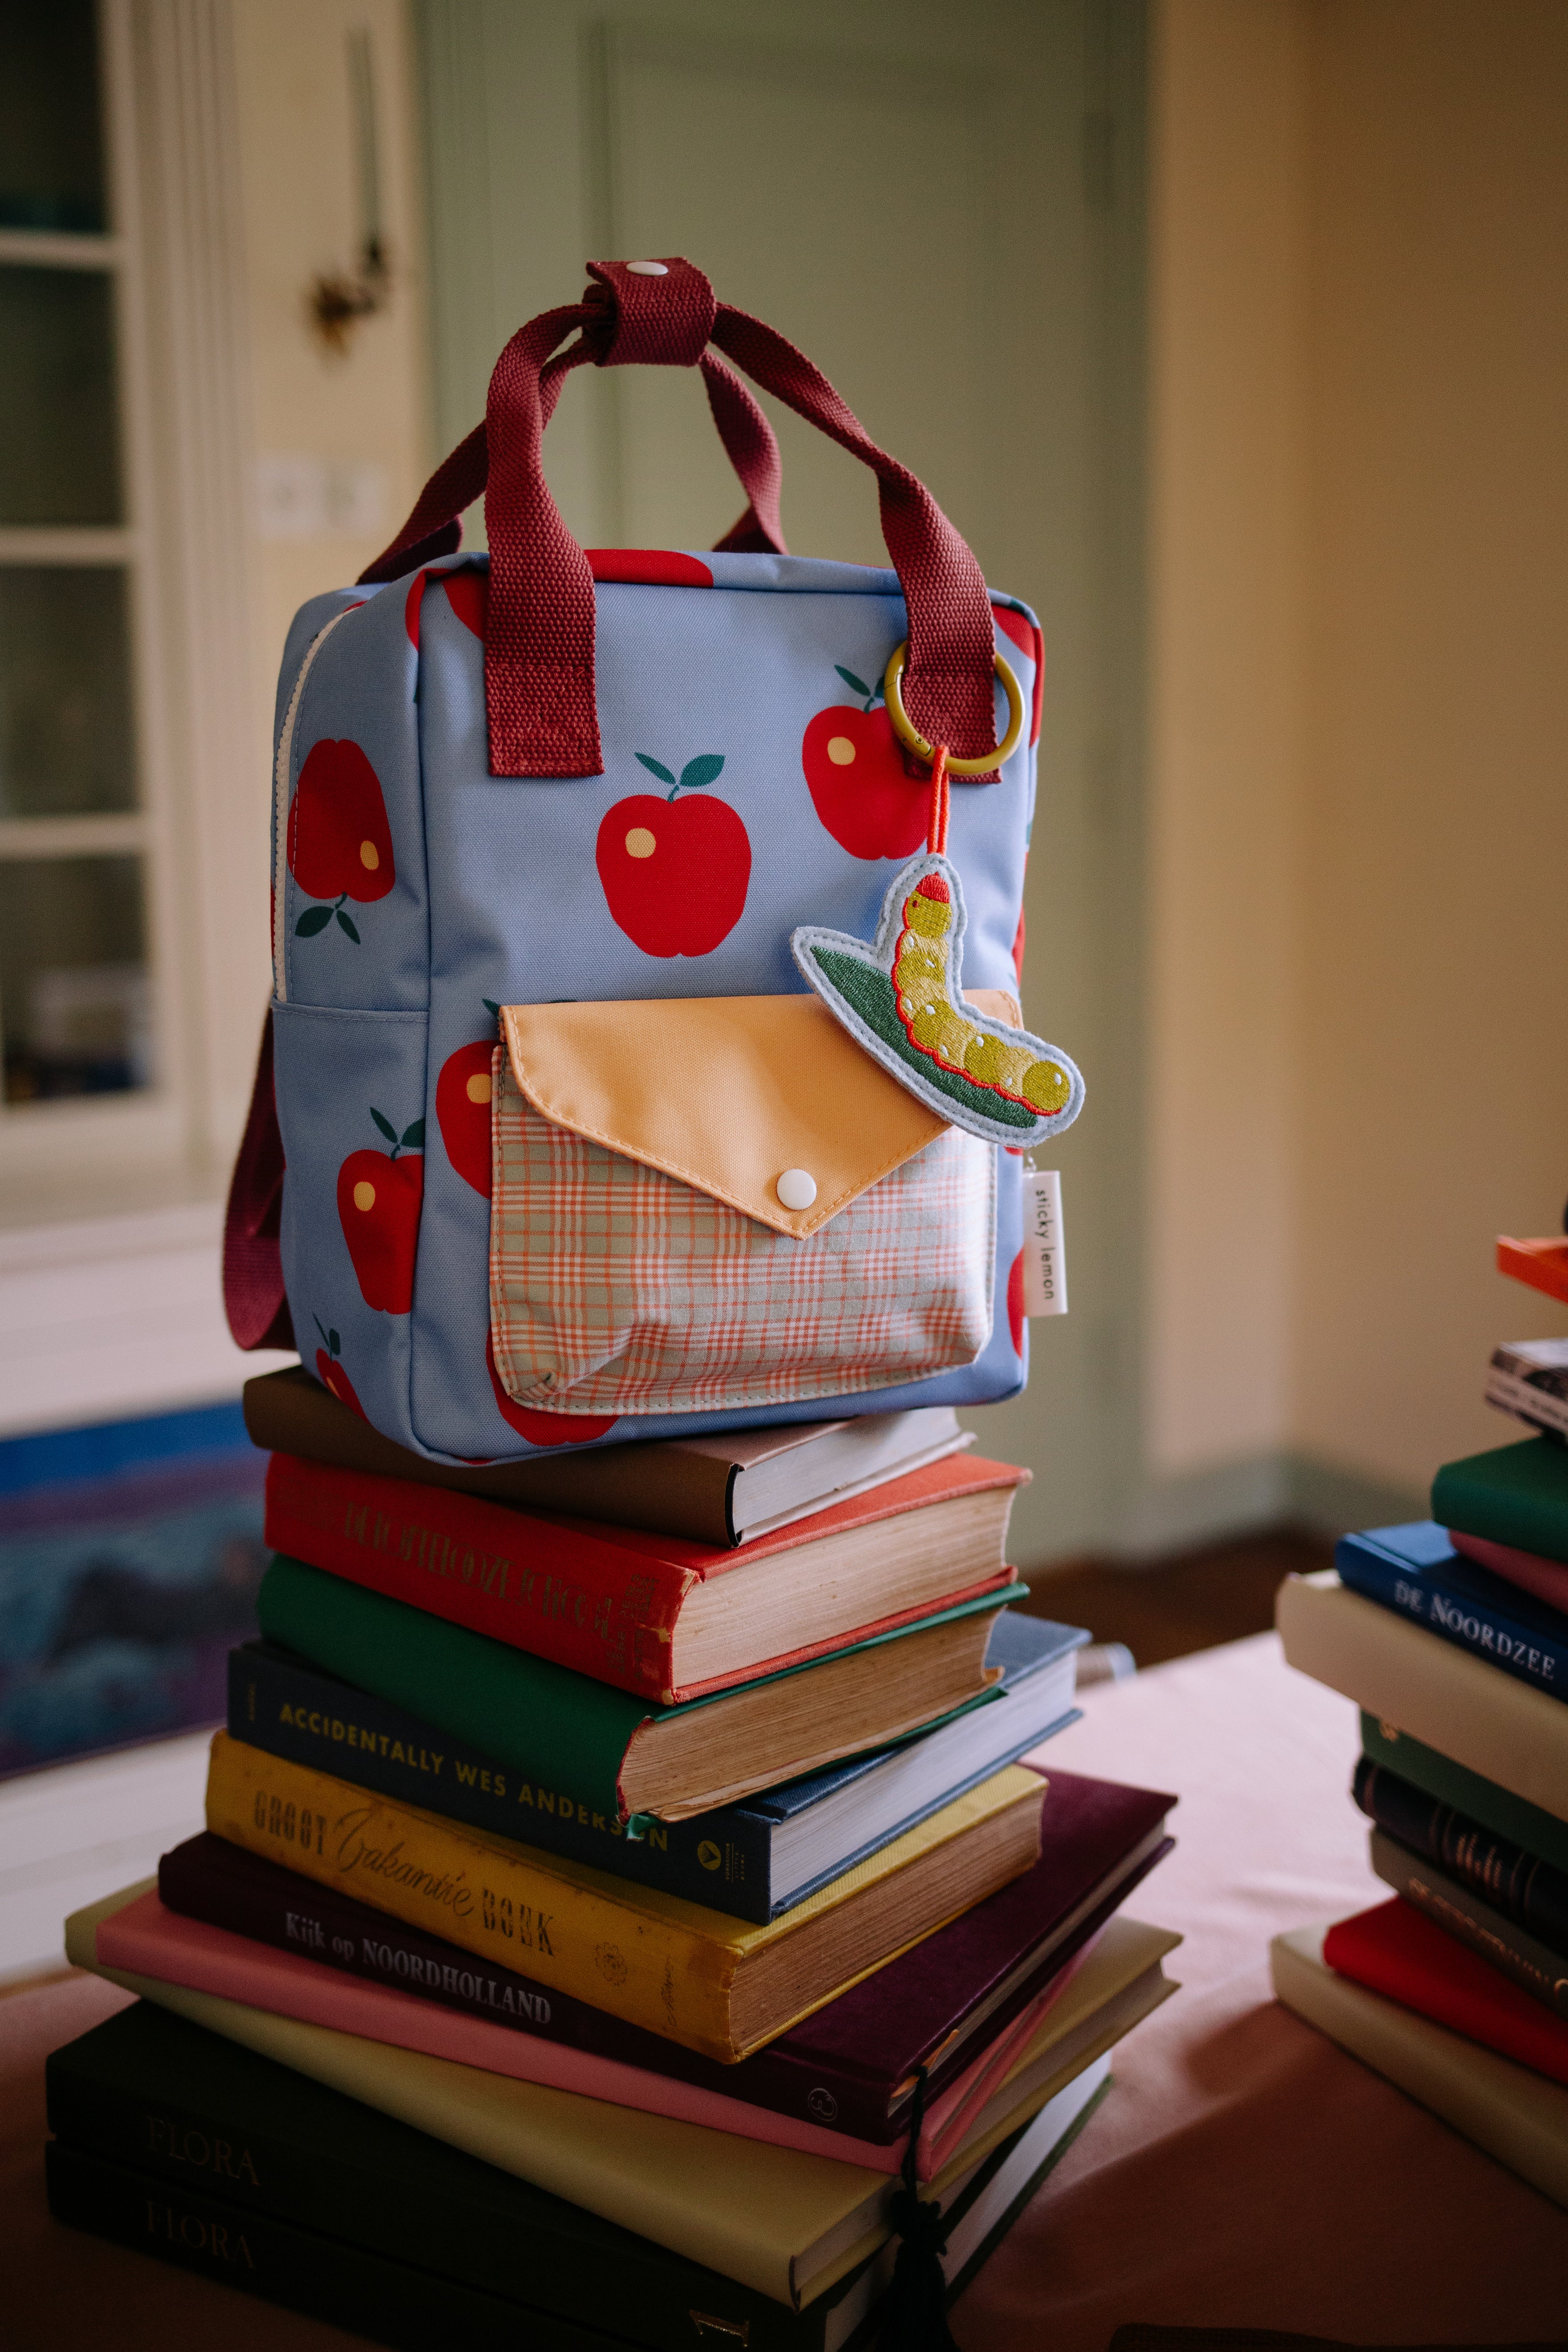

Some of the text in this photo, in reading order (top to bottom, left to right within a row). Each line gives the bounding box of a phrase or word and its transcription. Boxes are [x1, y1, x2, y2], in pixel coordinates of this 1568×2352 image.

[1035, 1189, 1056, 1300] sticky lemon
[1393, 1578, 1557, 1681] DE NOORDZEE
[279, 1703, 669, 1852] ACCIDENTALLY WES ANDERSN
[253, 1789, 327, 1855] GROOT
[481, 1887, 556, 1958] BOEK
[283, 1911, 553, 2026] Kijk op NOORDHOLLAND
[146, 2115, 262, 2187] FLORA
[146, 2200, 257, 2270] FLORA
